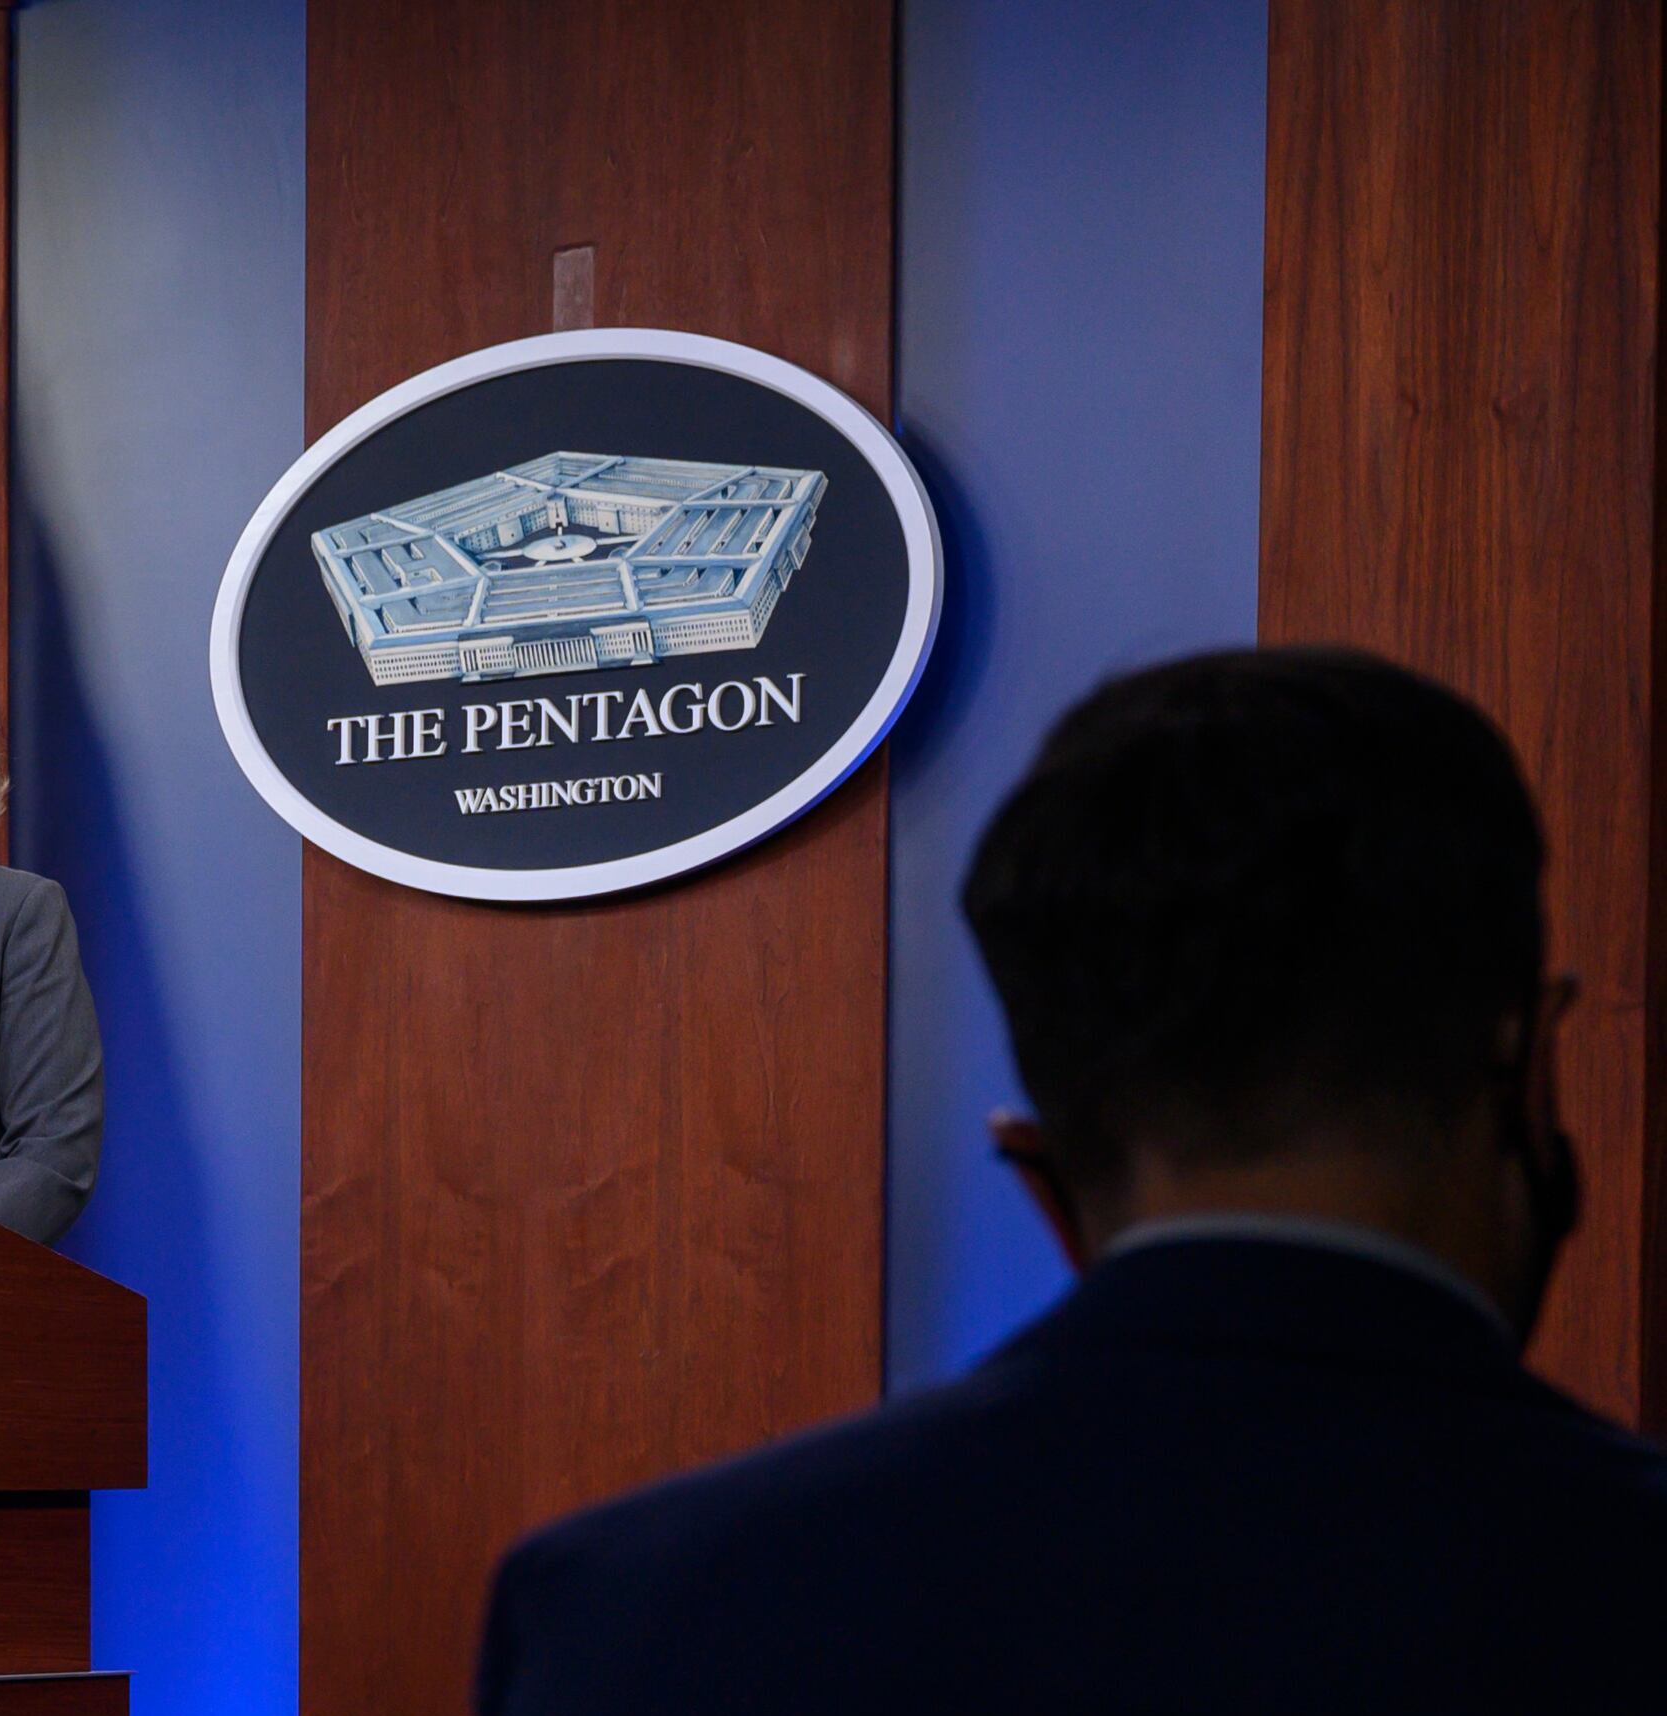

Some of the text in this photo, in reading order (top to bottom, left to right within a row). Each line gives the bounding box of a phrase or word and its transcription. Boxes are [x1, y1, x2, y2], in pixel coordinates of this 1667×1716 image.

[327, 673, 807, 766] THE PENTAGON
[453, 772, 664, 816] WASHINGTON
